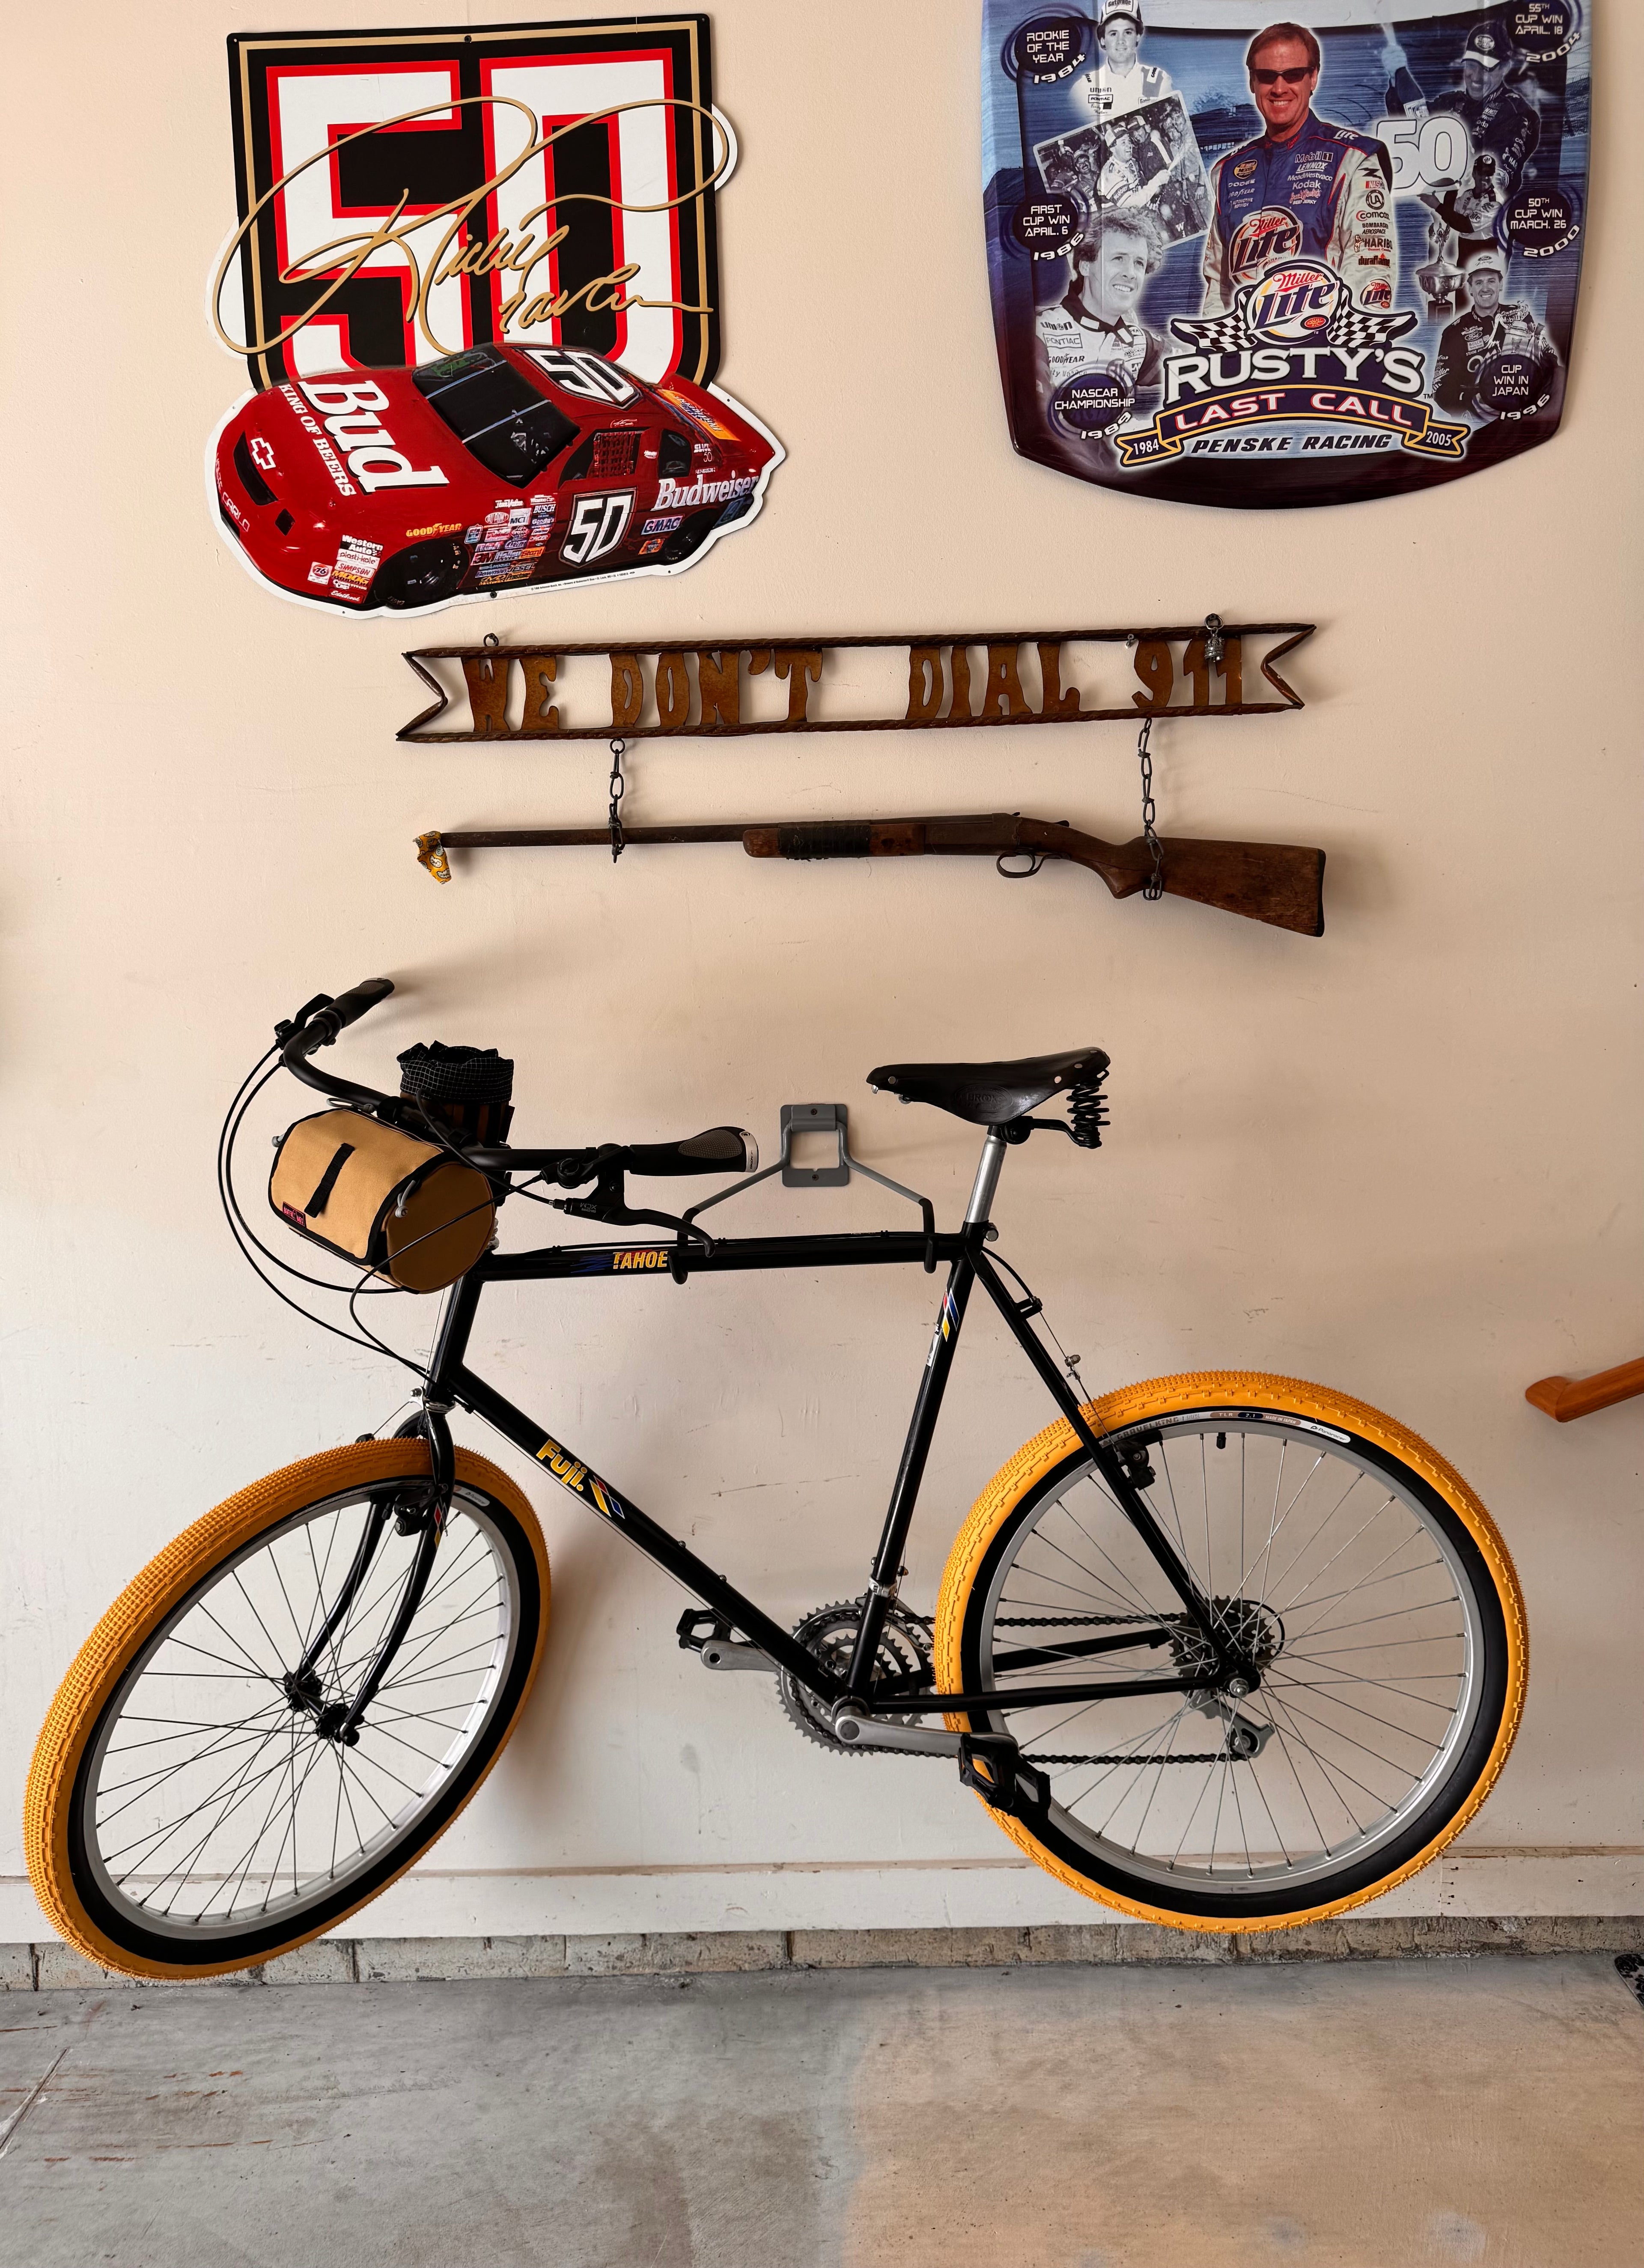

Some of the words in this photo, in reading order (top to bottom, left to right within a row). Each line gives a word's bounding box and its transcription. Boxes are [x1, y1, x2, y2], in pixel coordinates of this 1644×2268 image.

[1529, 3, 1549, 12] 55TH
[1516, 14, 1537, 23] CUP
[1542, 15, 1563, 24] WIN
[1027, 30, 1069, 42] ROOKIE
[1515, 25, 1550, 34] APRIL.
[1555, 26, 1563, 35] 18
[1027, 43, 1042, 53] OF
[1046, 41, 1069, 51] THE
[1526, 32, 1580, 63] 2004
[1033, 53, 1063, 63] YEAR
[1034, 54, 1085, 84] 1984
[1295, 151, 1322, 163] Mobil
[1377, 116, 1468, 189] 50
[1296, 162, 1328, 170] LENNOX
[1293, 180, 1321, 190] Kodak
[1031, 204, 1062, 214] FIRST
[1528, 198, 1549, 207] 50TH
[266, 48, 685, 383] 50
[1023, 216, 1044, 226] CUP
[1048, 215, 1070, 224] WIN
[1515, 209, 1537, 218] CUP
[1541, 209, 1562, 218] WIN
[1025, 227, 1059, 237] APRIL.
[1062, 226, 1068, 235] 6
[1249, 217, 1287, 233] Miller
[1510, 220, 1550, 229] MARCH.
[1554, 220, 1567, 229] 26
[1033, 233, 1084, 260] 1986
[1523, 225, 1580, 257] 2000
[1232, 224, 1299, 275] Lite
[1273, 272, 1322, 289] Miller
[1253, 282, 1337, 330] Lite
[1166, 347, 1422, 404] RUSTY'S
[1501, 365, 1522, 373] CUP
[1494, 376, 1514, 385] WIN
[1519, 376, 1528, 384] IN
[1072, 388, 1118, 398] NASCAR
[1492, 386, 1528, 396] JAPAN
[1054, 398, 1135, 410] CHAMPIONSHIP
[1175, 392, 1285, 430] LAST
[1310, 393, 1413, 427] CALL
[1500, 394, 1550, 420] 1996
[1081, 412, 1132, 439] 1989
[278, 384, 308, 414] KING
[300, 415, 322, 436] OF
[312, 437, 357, 496] BEERS
[297, 380, 450, 493] Bud
[1426, 431, 1452, 446] 2005
[1134, 439, 1159, 455] 1984
[1191, 437, 1292, 454] PENSKE
[1302, 435, 1392, 450] RACING
[703, 452, 713, 462] 50
[650, 470, 759, 511] Budweiser
[533, 504, 556, 513] BUSCH
[405, 523, 462, 538] GOODYEAR
[563, 494, 634, 563] 50
[644, 517, 681, 533] GMAC
[342, 535, 383, 551] Western
[348, 544, 372, 555] Auto
[339, 563, 371, 576] SIMPSON
[332, 570, 370, 584] MOOG
[331, 590, 360, 602] Edelbrock
[461, 654, 559, 733] WE
[609, 648, 822, 728] DON'T
[905, 642, 1081, 719] DIAL
[1132, 634, 1242, 708] 911
[613, 1250, 668, 1270] TAHOE
